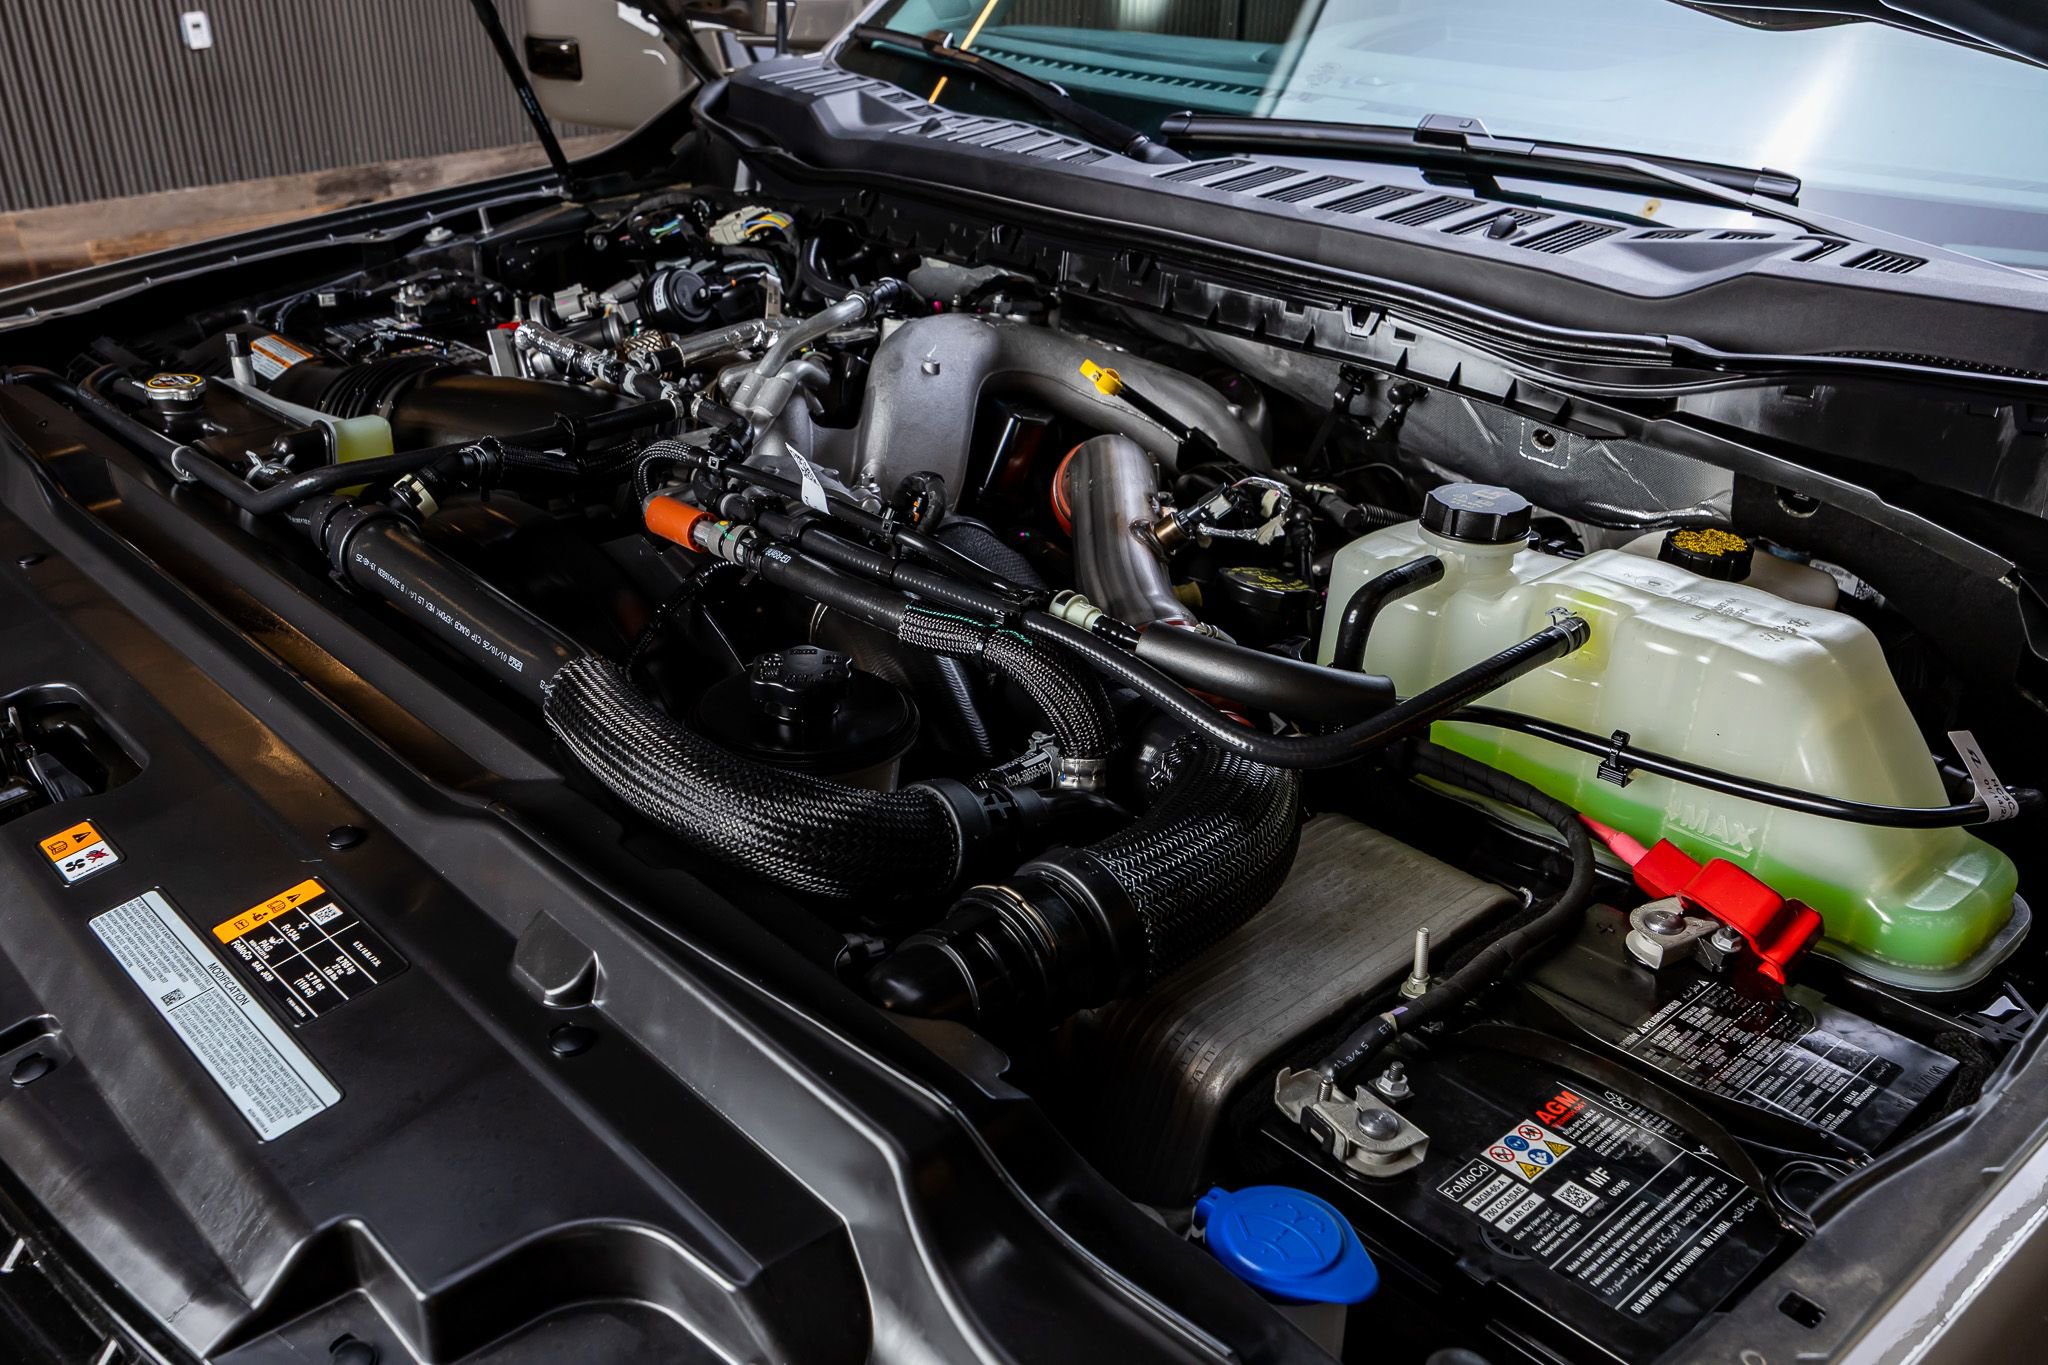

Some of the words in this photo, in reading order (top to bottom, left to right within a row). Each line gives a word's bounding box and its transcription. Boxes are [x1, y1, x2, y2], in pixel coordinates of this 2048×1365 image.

[1680, 803, 1757, 852] MAX
[230, 939, 255, 961] FoMoCo
[250, 960, 265, 972] SAE
[258, 939, 274, 952] PAG
[205, 961, 250, 1006] MODIFICATION
[303, 971, 318, 981] 3.7
[1531, 1088, 1581, 1125] AGM
[1562, 1108, 1597, 1136] NON-SPILLABLE
[1568, 1129, 1582, 1139] Lead
[1578, 1121, 1591, 1131] Acid
[1586, 1111, 1605, 1125] Battery
[1593, 1138, 1614, 1153] CONTRA
[1442, 1160, 1490, 1199] FoMoCo
[1583, 1166, 1615, 1189] MF
[1470, 1178, 1507, 1207] BAGM-65-A
[1504, 1215, 1516, 1225] 68
[1511, 1208, 1525, 1219] Ah
[1519, 1199, 1536, 1212] C20
[1706, 1230, 1721, 1241] LA
[1711, 1218, 1735, 1235] ABRA.
[1530, 1239, 1546, 1251] Ford
[1540, 1229, 1558, 1243] Motor
[1564, 1258, 1582, 1272] Made
[1580, 1247, 1595, 1258] USA
[1588, 1240, 1603, 1251] with
[1603, 1228, 1616, 1238] and
[1610, 1213, 1633, 1232] imported
[1594, 1254, 1607, 1264] aux
[1629, 1223, 1642, 1233] des
[1699, 1236, 1715, 1248] NO
[1614, 1255, 1627, 1264] los
[1678, 1243, 1707, 1266] OUVRIR.
[1662, 1270, 1678, 1282] NE
[1669, 1261, 1688, 1275] PAS
[1646, 1278, 1671, 1297] OPEN.
[1629, 1301, 1646, 1314] DO
[1636, 1292, 1655, 1307] NOT
